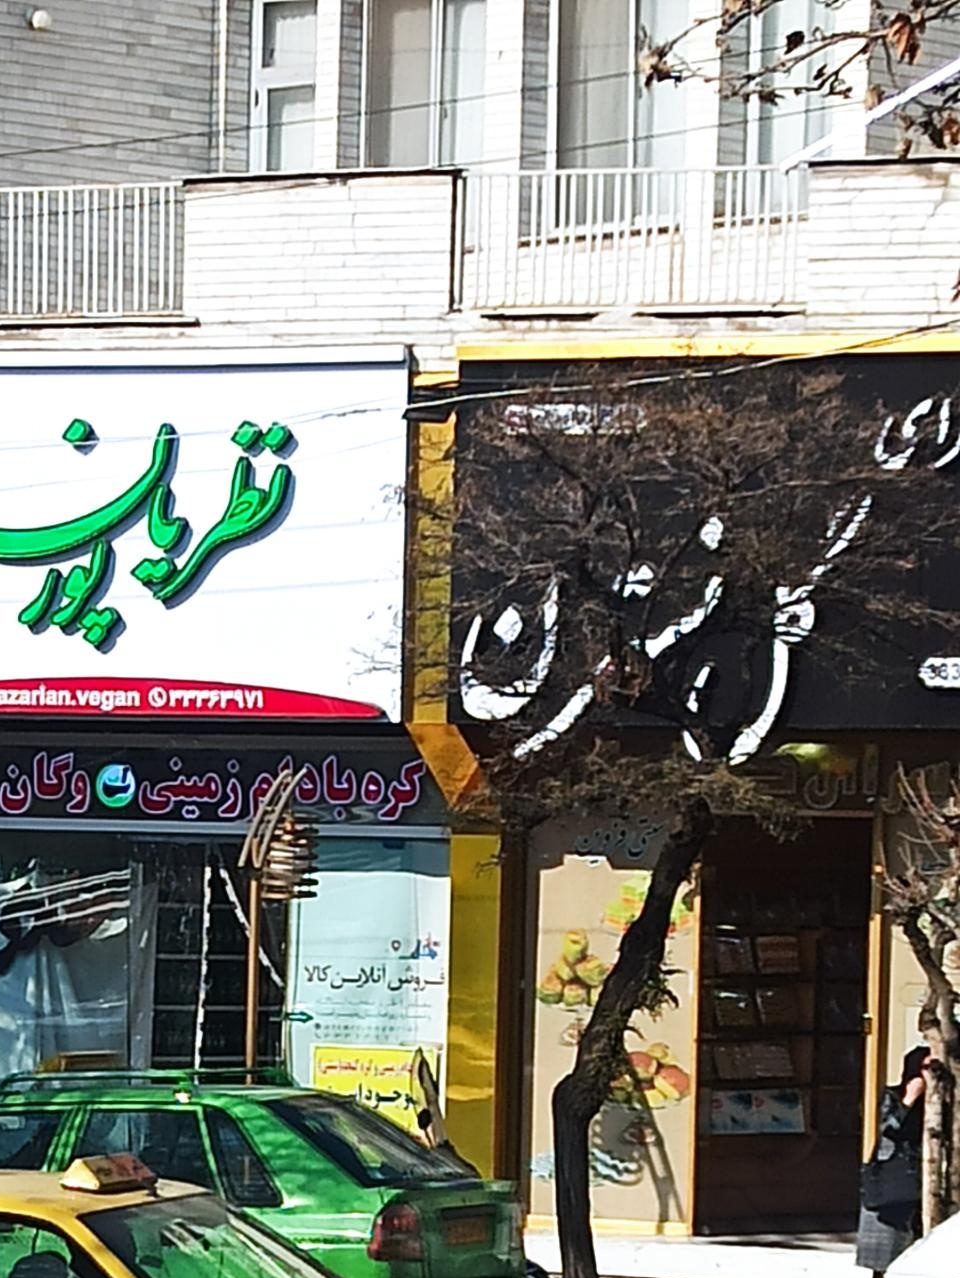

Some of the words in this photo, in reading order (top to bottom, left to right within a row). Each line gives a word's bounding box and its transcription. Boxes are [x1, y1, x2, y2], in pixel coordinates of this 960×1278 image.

[18, 539, 126, 654] پور
[139, 756, 241, 818] زمینی
[361, 758, 426, 820] کره
[304, 965, 332, 984] کالا
